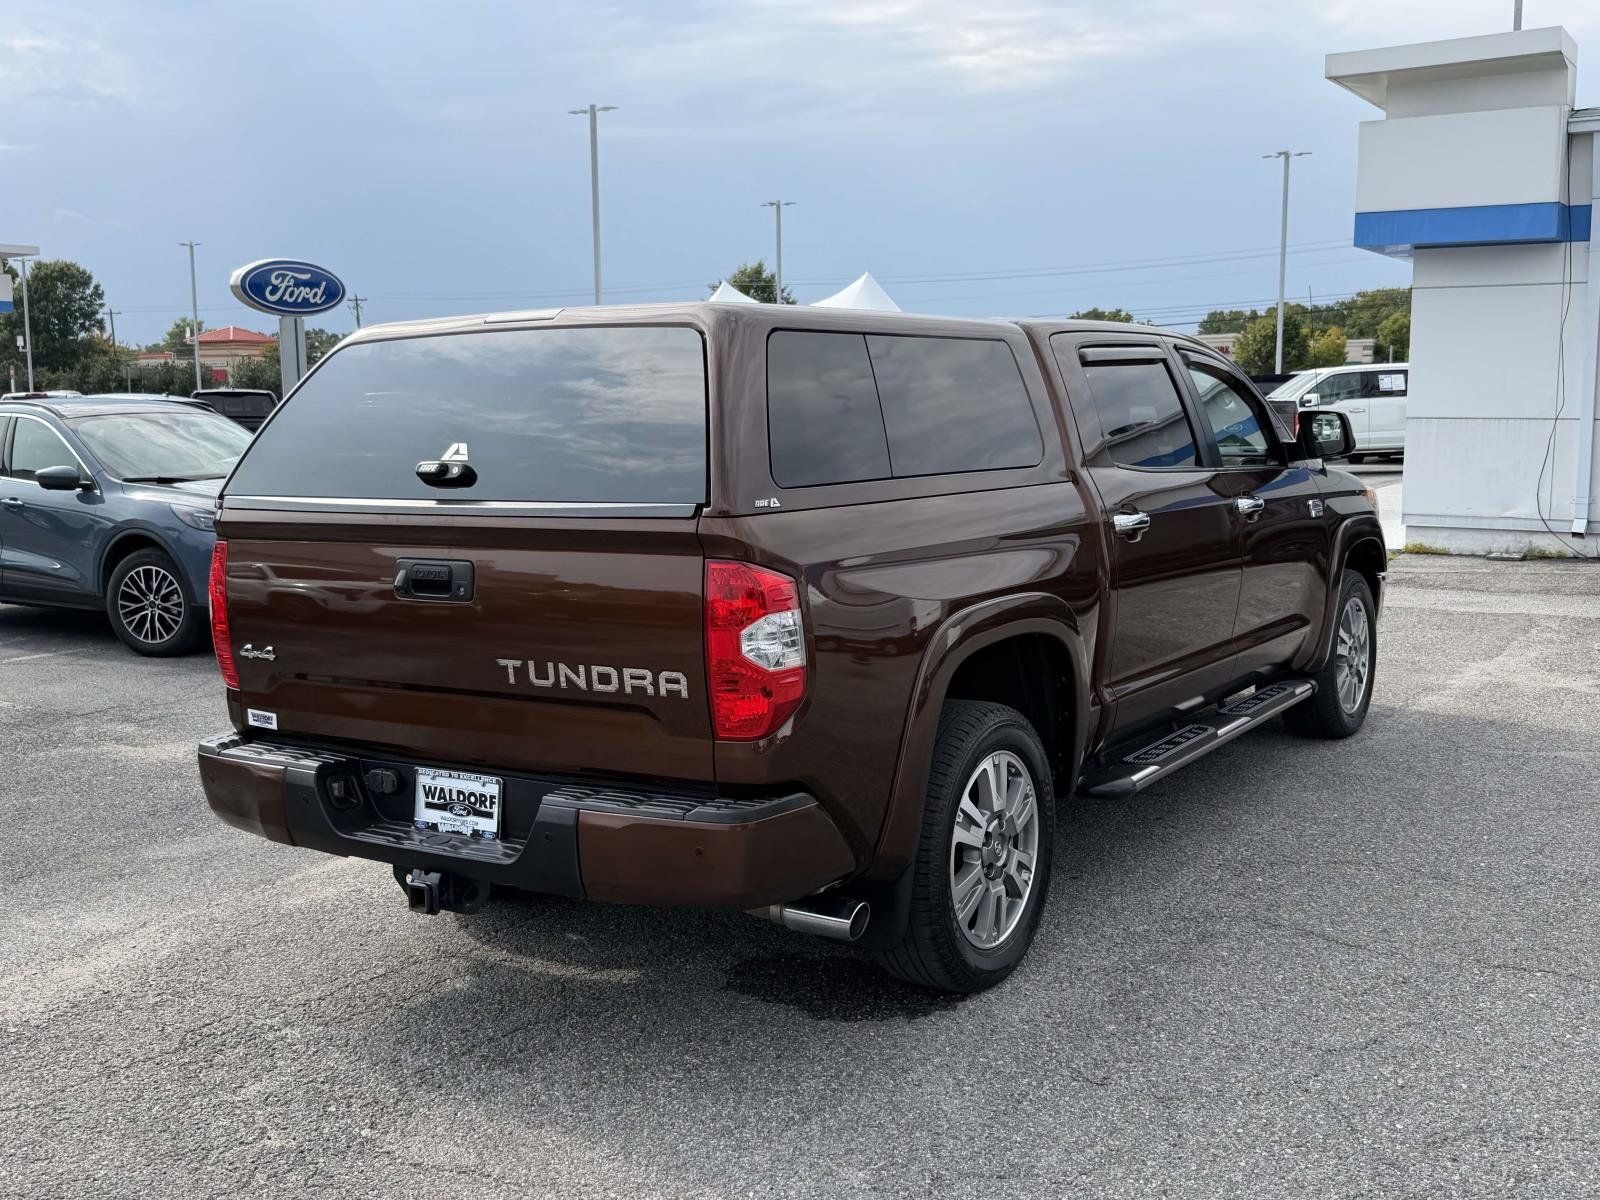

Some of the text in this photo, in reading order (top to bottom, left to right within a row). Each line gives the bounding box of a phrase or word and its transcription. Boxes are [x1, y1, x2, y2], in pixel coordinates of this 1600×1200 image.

[265, 270, 327, 304] Ford
[754, 499, 769, 507] ARE
[240, 644, 276, 661] 4x4
[496, 658, 689, 699] TUNDRA
[418, 768, 450, 778] DEDICATED
[422, 784, 497, 810] WALDORF
[452, 805, 467, 816] Ford
[437, 822, 474, 837] WALDORF
